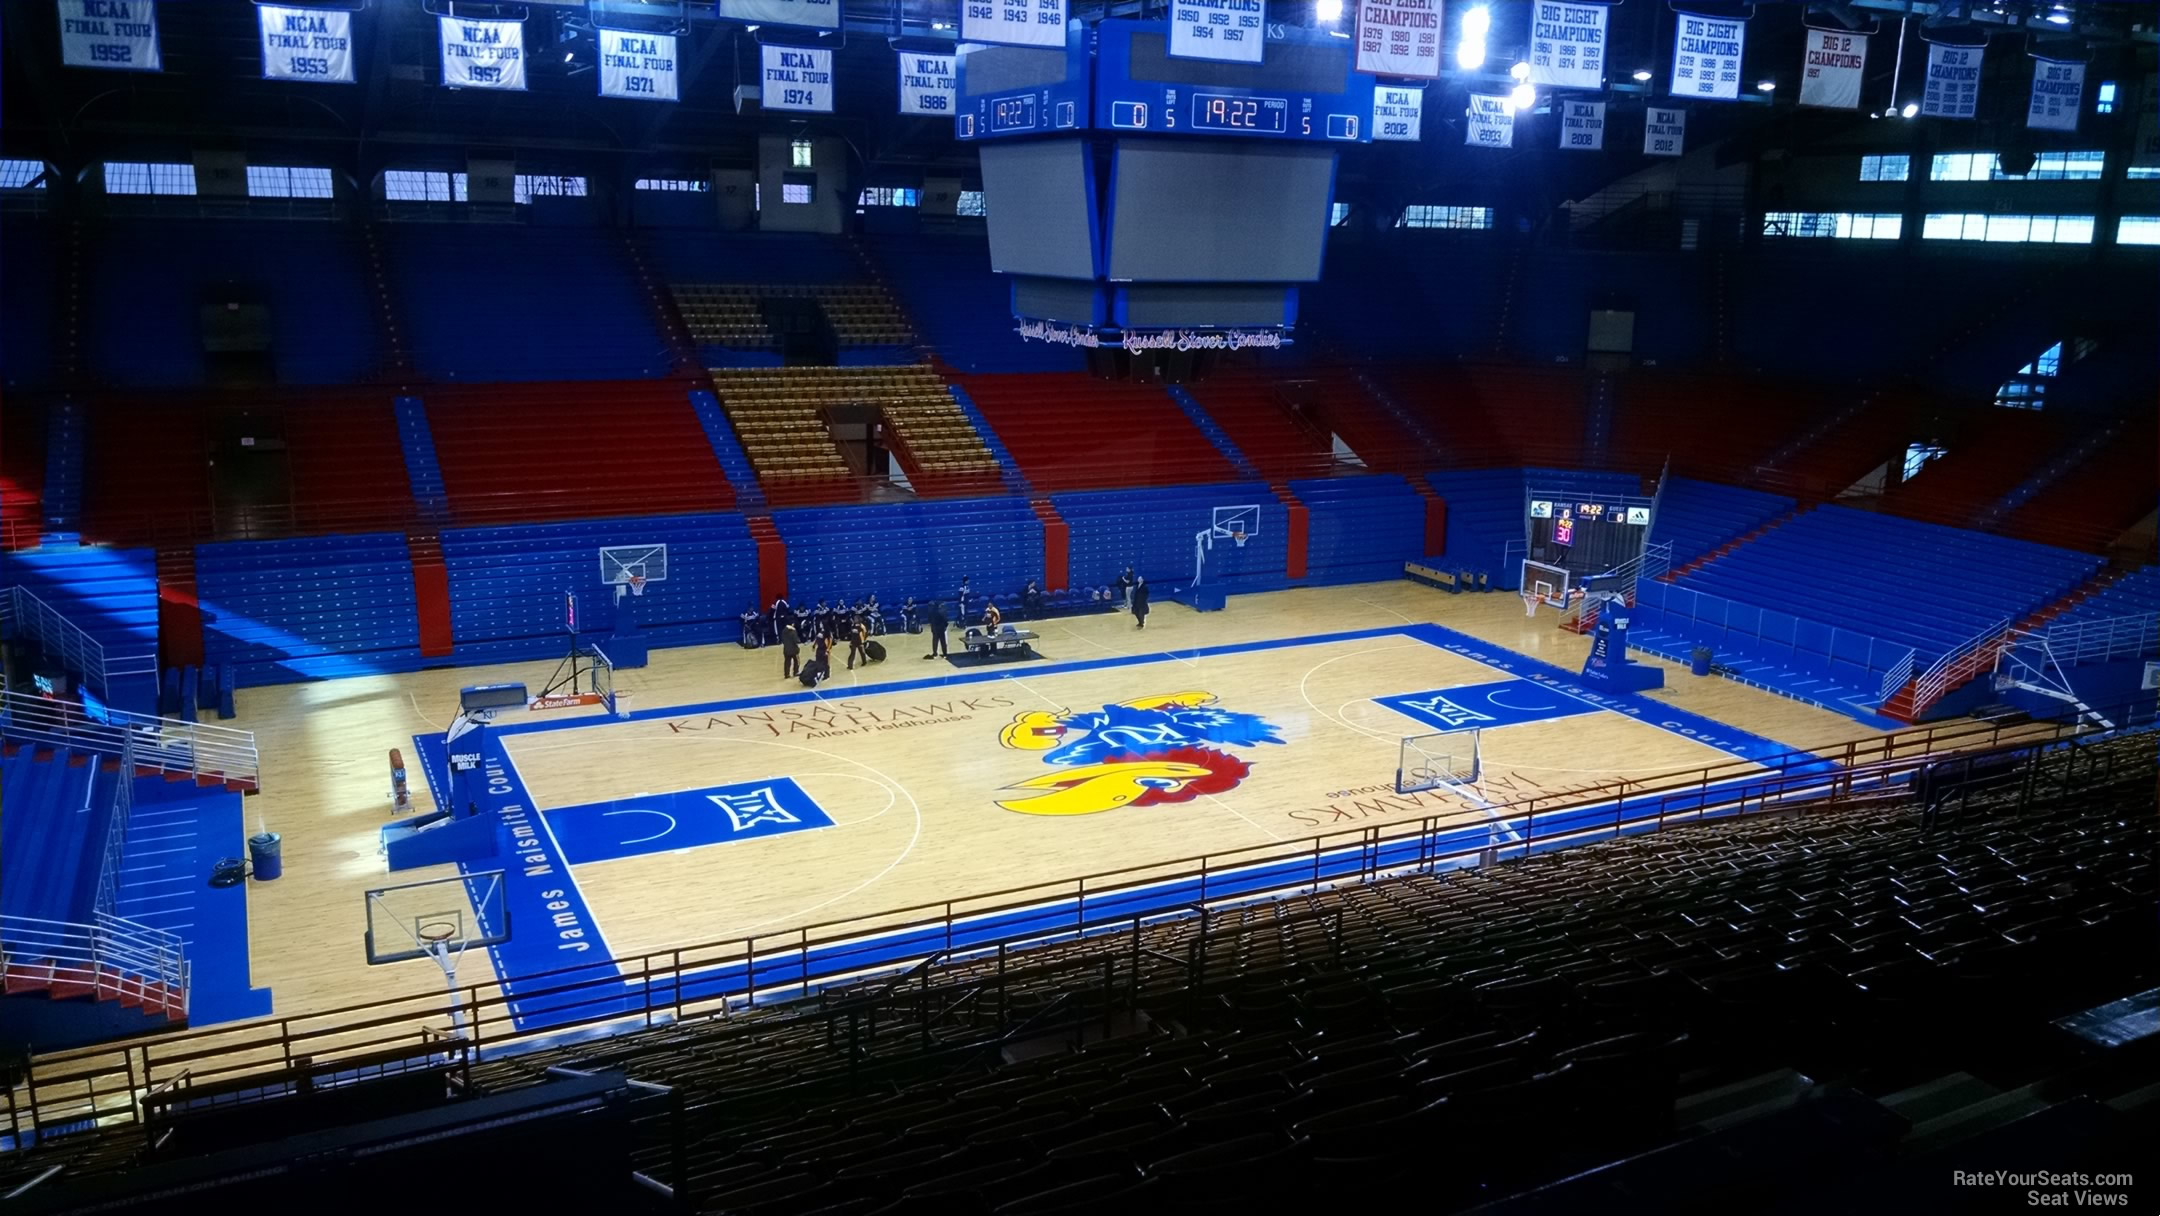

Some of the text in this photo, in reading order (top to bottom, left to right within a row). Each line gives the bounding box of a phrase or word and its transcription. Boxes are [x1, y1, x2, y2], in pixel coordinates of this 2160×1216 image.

[84, 0, 130, 19] NCAA
[968, 6, 1061, 25] 1942 1943 1946
[1365, 6, 1437, 29] CHAMPIONS
[1542, 5, 1599, 25] BIG EIGHT
[285, 16, 328, 33] NCAA
[1177, 9, 1259, 28] 1950 1952 1953
[65, 19, 150, 37] FINAL FOUR
[463, 26, 502, 44] NCAA
[1192, 26, 1244, 41] 1954 1957
[1363, 27, 1435, 44] 1979 1980 1981
[1536, 22, 1602, 43] CHAMPIONS
[1686, 20, 1738, 39] BIG EIGHT
[269, 34, 347, 50] FINAL FOUR
[621, 38, 657, 55] NCAA
[1363, 41, 1435, 57] 1987 1992 1996
[1535, 42, 1600, 57] 1960 1966 1967
[1681, 37, 1739, 56] CHAMPIONS
[1823, 36, 1851, 52] BIG 12
[90, 44, 132, 62] 1952
[448, 44, 519, 60] FINAL FOUR
[1808, 51, 1861, 69] CHAMPIONS
[1942, 50, 1968, 65] BIG 12
[290, 57, 328, 74] 1953
[605, 54, 673, 71] FINAL FOUR
[781, 52, 814, 69] NCAA
[917, 59, 948, 75] NCAA
[1534, 55, 1599, 70] 1971 1974 1975
[468, 66, 501, 82] 1957
[766, 69, 829, 85] FINAL FOUR
[1930, 64, 1978, 80] CHAMPIONS
[2047, 67, 2061, 79] BIG
[625, 76, 655, 93] 1971
[904, 75, 956, 89] FINAL FOU
[2036, 80, 2080, 95] CHAMPIONS
[784, 89, 813, 105] 1974
[919, 95, 947, 110] 1986
[1264, 101, 1284, 109] PERIOD
[1385, 92, 1409, 105] NCAA
[1067, 104, 1072, 124] 0
[1206, 100, 1257, 126] 19:22
[1375, 106, 1418, 118] FINAL FOUR
[1481, 100, 1504, 113] NCAA
[1573, 105, 1594, 117] NCAA
[1133, 105, 1144, 126] 0
[1166, 109, 1174, 127] 5
[1275, 112, 1279, 129] 1
[1471, 114, 1512, 126] FINAL FOUR
[1565, 117, 1602, 129] FINAL FOUR
[1656, 112, 1675, 124] NCAA
[968, 116, 974, 135] 0
[1302, 117, 1310, 134] 5
[1346, 118, 1355, 137] 0
[1384, 122, 1408, 135] 2002
[1648, 124, 1683, 135] FINAL FOUR
[1572, 133, 1592, 145] 2008
[1655, 139, 1673, 151] 2012
[1122, 328, 1284, 355] Russell Stover Candies
[1580, 504, 1602, 514] 19:22
[1557, 527, 1570, 542] 30
[1443, 644, 1747, 752] James Naismith Court
[483, 711, 497, 719] KU
[667, 701, 862, 733] KANSAS
[764, 695, 1015, 737] JAYHAWKS
[806, 713, 973, 740] Allen Fieldhouse
[452, 754, 480, 763] MUSCLE
[457, 761, 476, 770] MILK
[497, 804, 554, 877] Naismith
[541, 889, 590, 952] James
